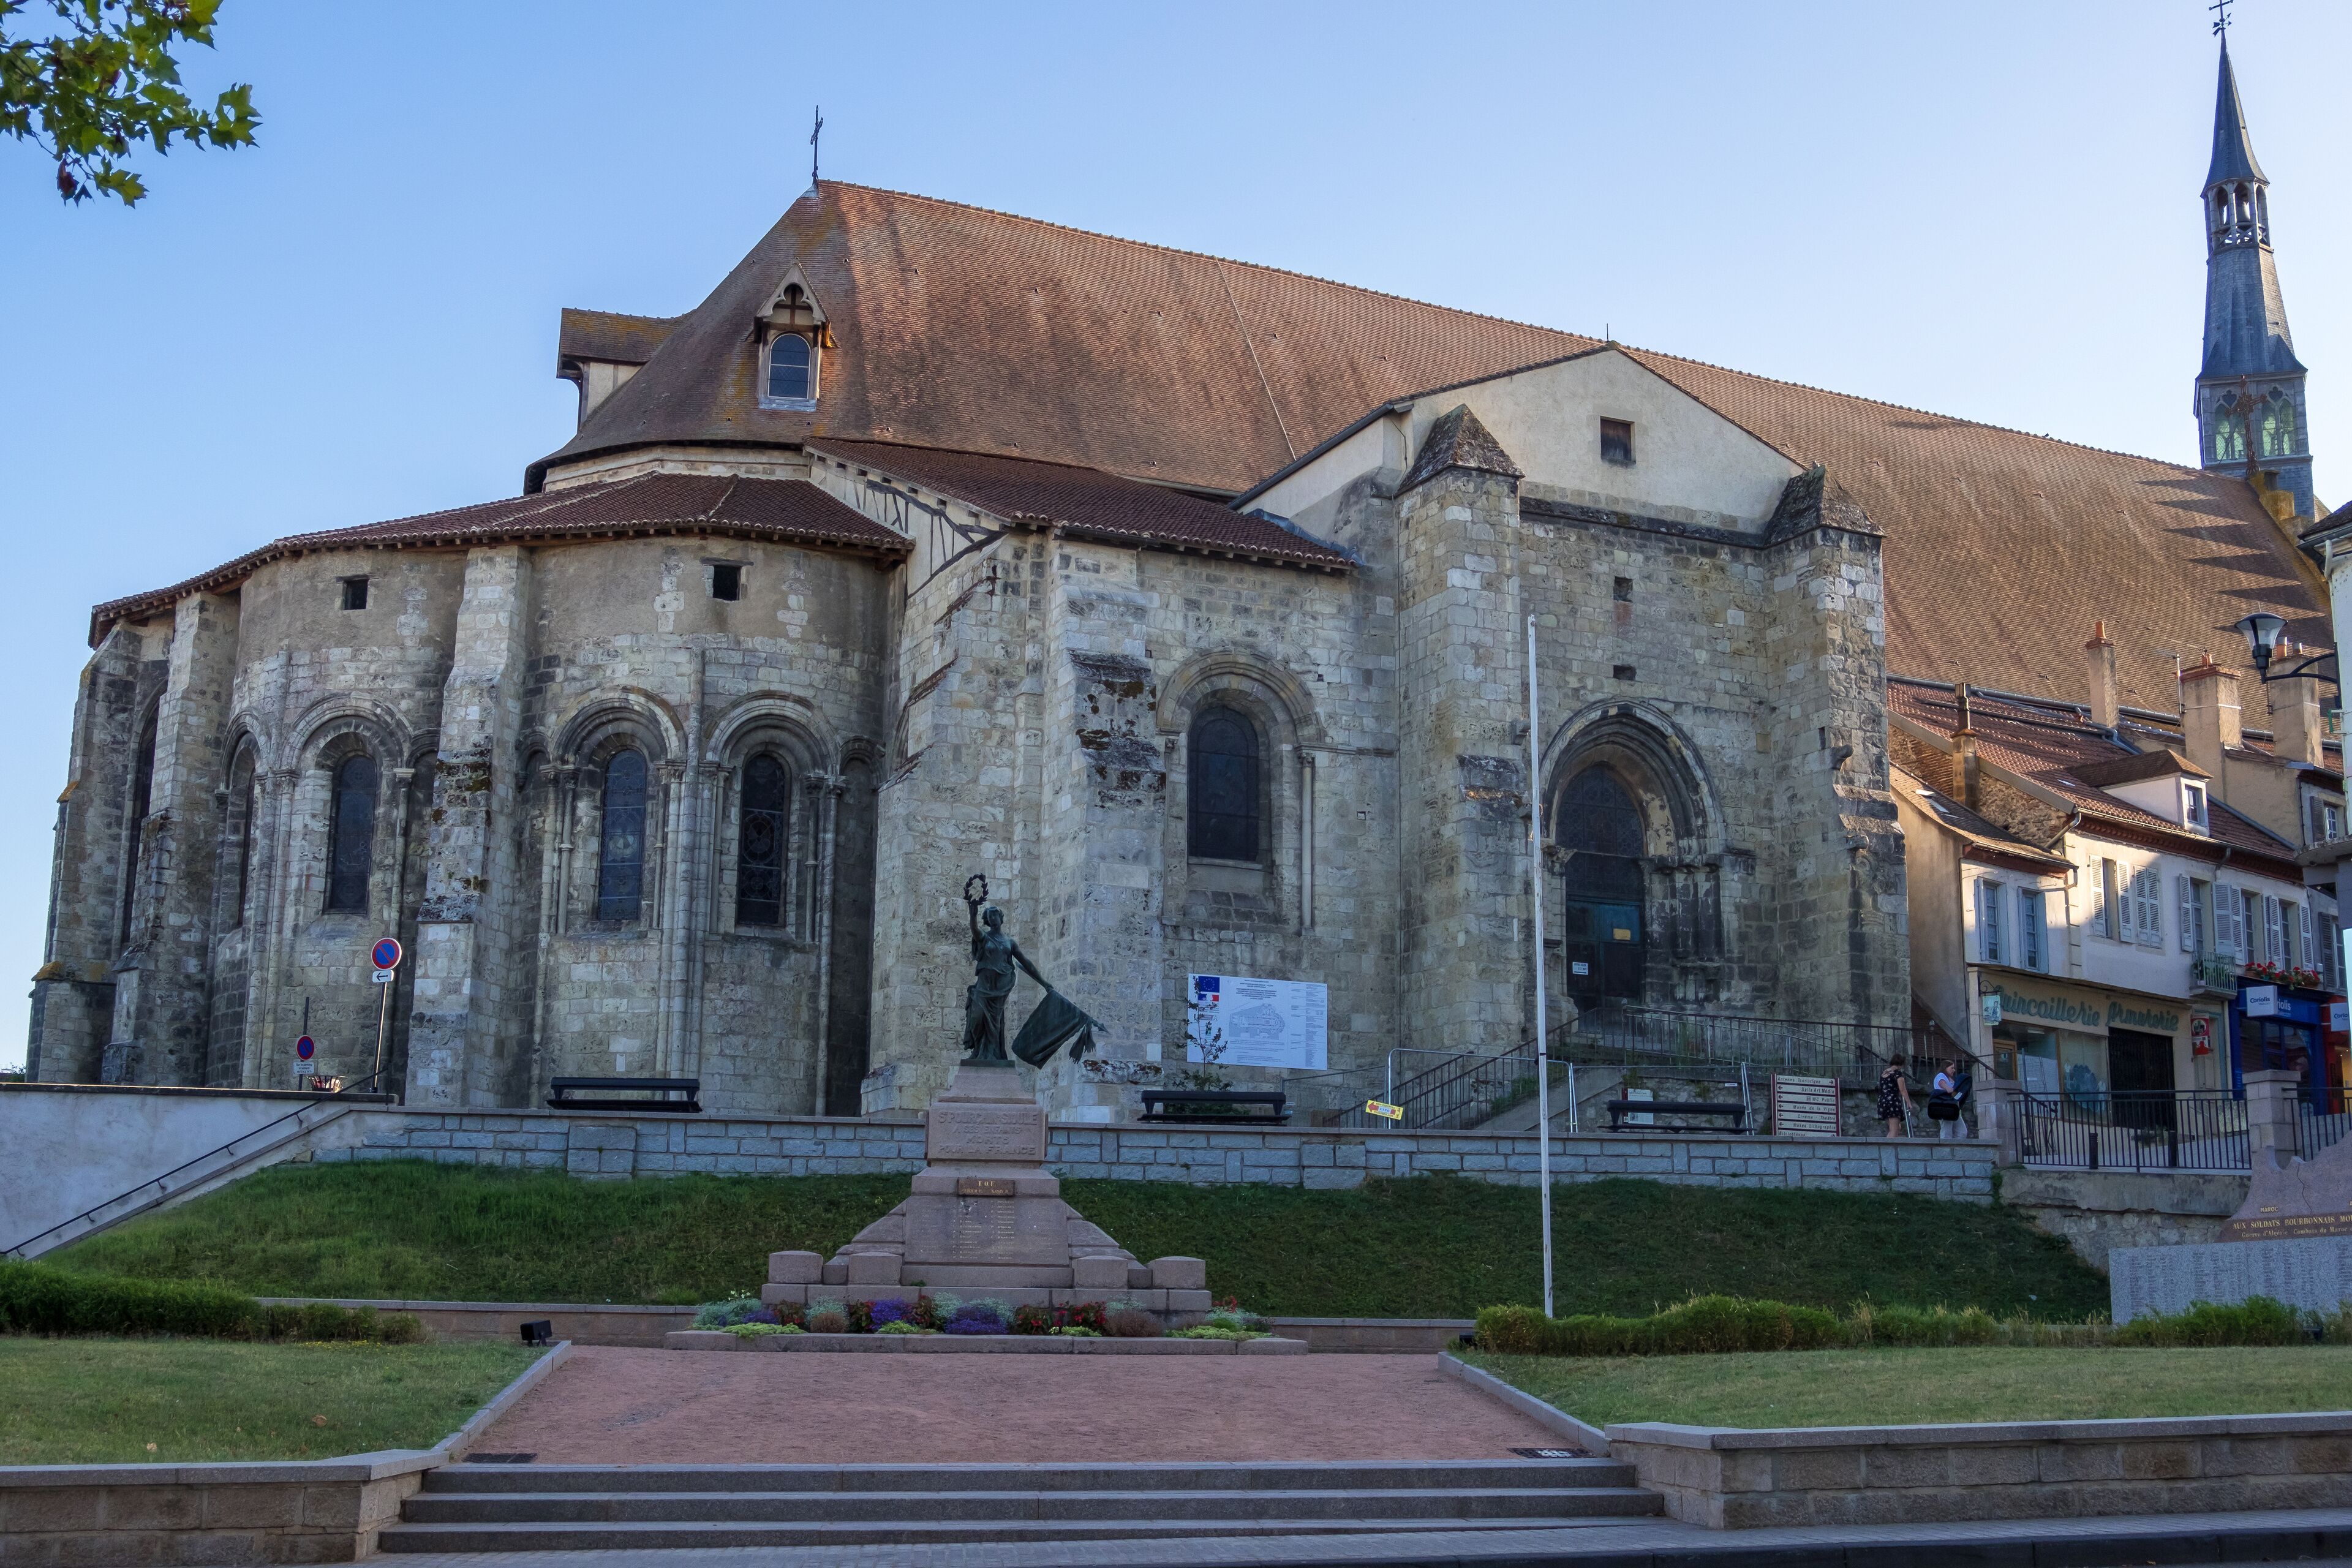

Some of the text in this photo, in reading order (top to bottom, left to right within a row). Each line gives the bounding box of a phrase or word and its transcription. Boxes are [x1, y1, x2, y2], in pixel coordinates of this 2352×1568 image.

[2278, 998, 2291, 1011] iolis
[963, 1125, 980, 1134] SES
[938, 1144, 1037, 1156] POUR LA FRANCE
[2250, 1219, 2280, 1229] SOLDATS
[2285, 1216, 2335, 1226] BOURBONNAIS
